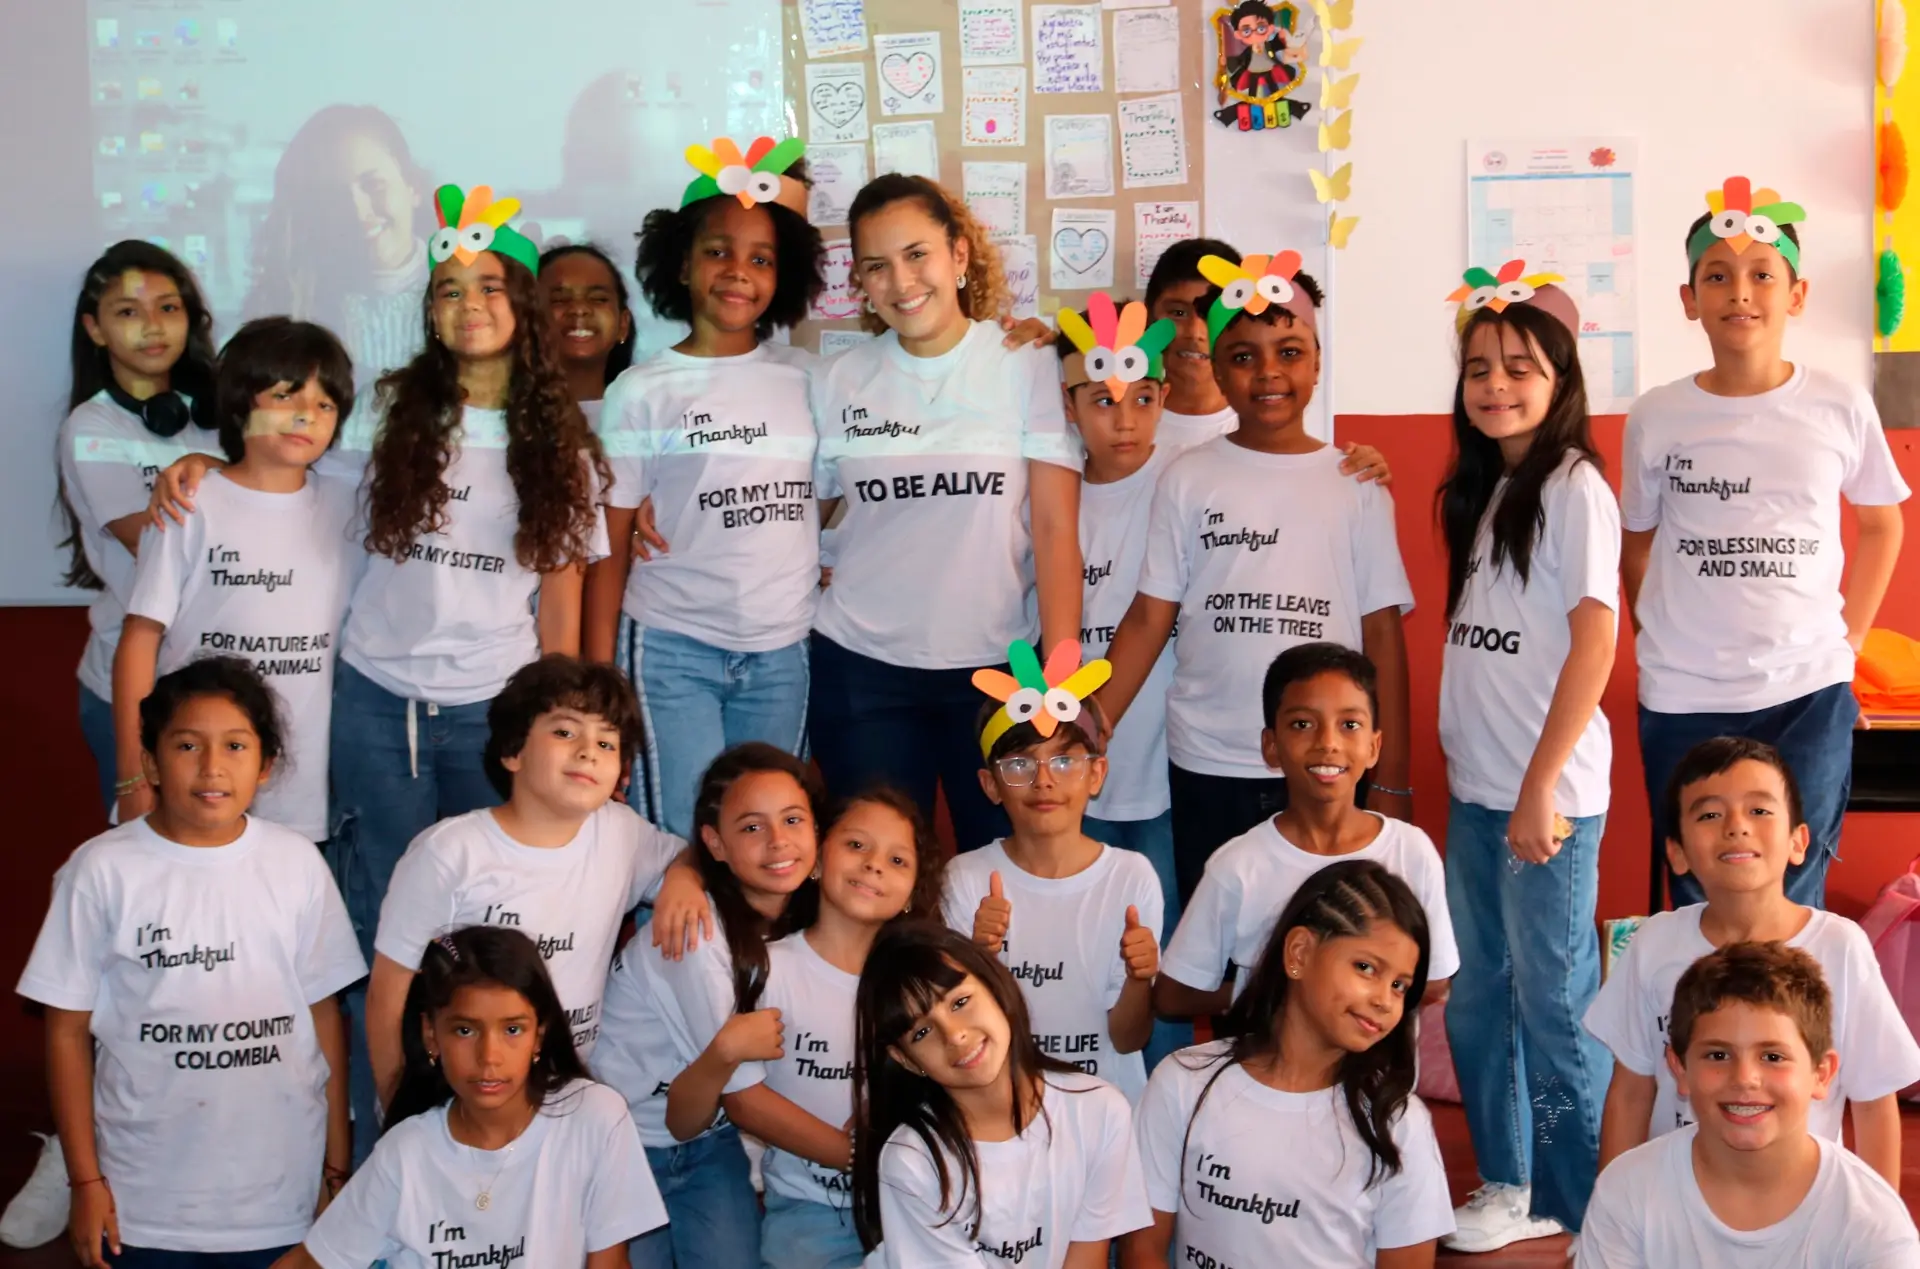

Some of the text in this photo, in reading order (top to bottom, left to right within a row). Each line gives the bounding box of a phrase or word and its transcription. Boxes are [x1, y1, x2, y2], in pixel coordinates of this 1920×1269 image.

[686, 422, 768, 448] Thankful
[845, 420, 921, 442] Thankful
[698, 487, 739, 511] FOR
[741, 484, 770, 503] MY
[855, 471, 1006, 502] TO BE ALIVE
[1669, 476, 1751, 500] Thankful
[723, 503, 804, 528] BROTHER
[1200, 527, 1279, 552] Thankful
[1677, 539, 1705, 556] FOR
[1707, 537, 1796, 556] BLESSINGS
[424, 545, 450, 565] MY
[450, 551, 506, 574] SISTER
[1698, 560, 1796, 578] AND SMALL
[210, 568, 294, 592] Thankful
[1205, 592, 1331, 617] FOR THE LEAVES
[1213, 616, 1323, 639] ON THE TREES
[1470, 625, 1521, 655] DOG
[200, 632, 236, 651] FOR
[239, 636, 308, 652] NATURE
[257, 656, 322, 676] ANIMALS
[140, 942, 235, 972] Thankful
[140, 1014, 295, 1044] FOR MY COUNTRY
[1065, 1033, 1099, 1053] LIFE
[175, 1045, 281, 1070] COLOMBIA
[1197, 1180, 1301, 1224] Thankful
